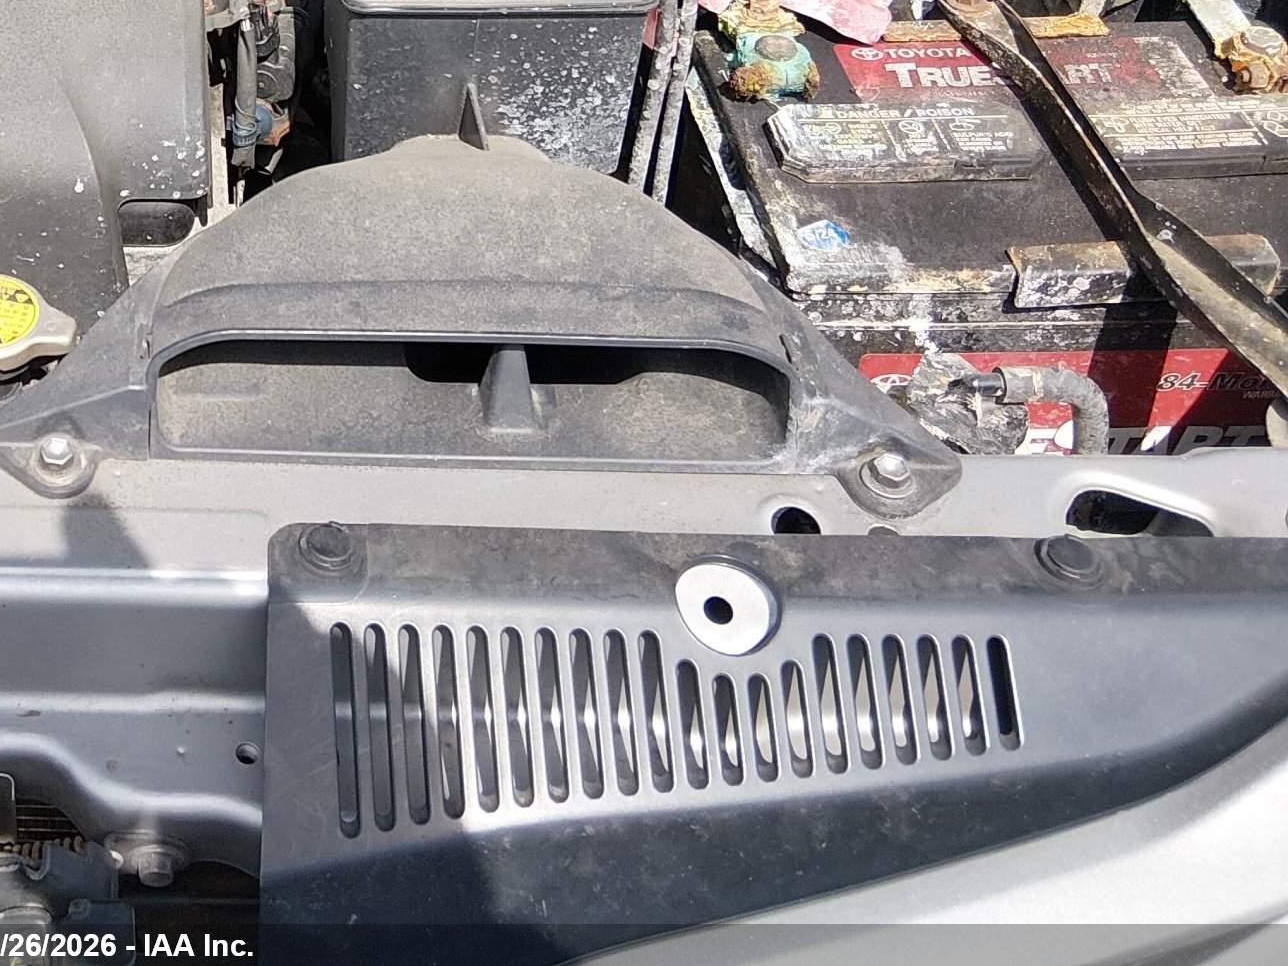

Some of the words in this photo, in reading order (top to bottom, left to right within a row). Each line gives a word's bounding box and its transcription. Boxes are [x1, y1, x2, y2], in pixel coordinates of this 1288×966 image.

[884, 47, 971, 59] TOYOTA
[835, 109, 901, 118] DANGER
[915, 107, 975, 117] POISON
